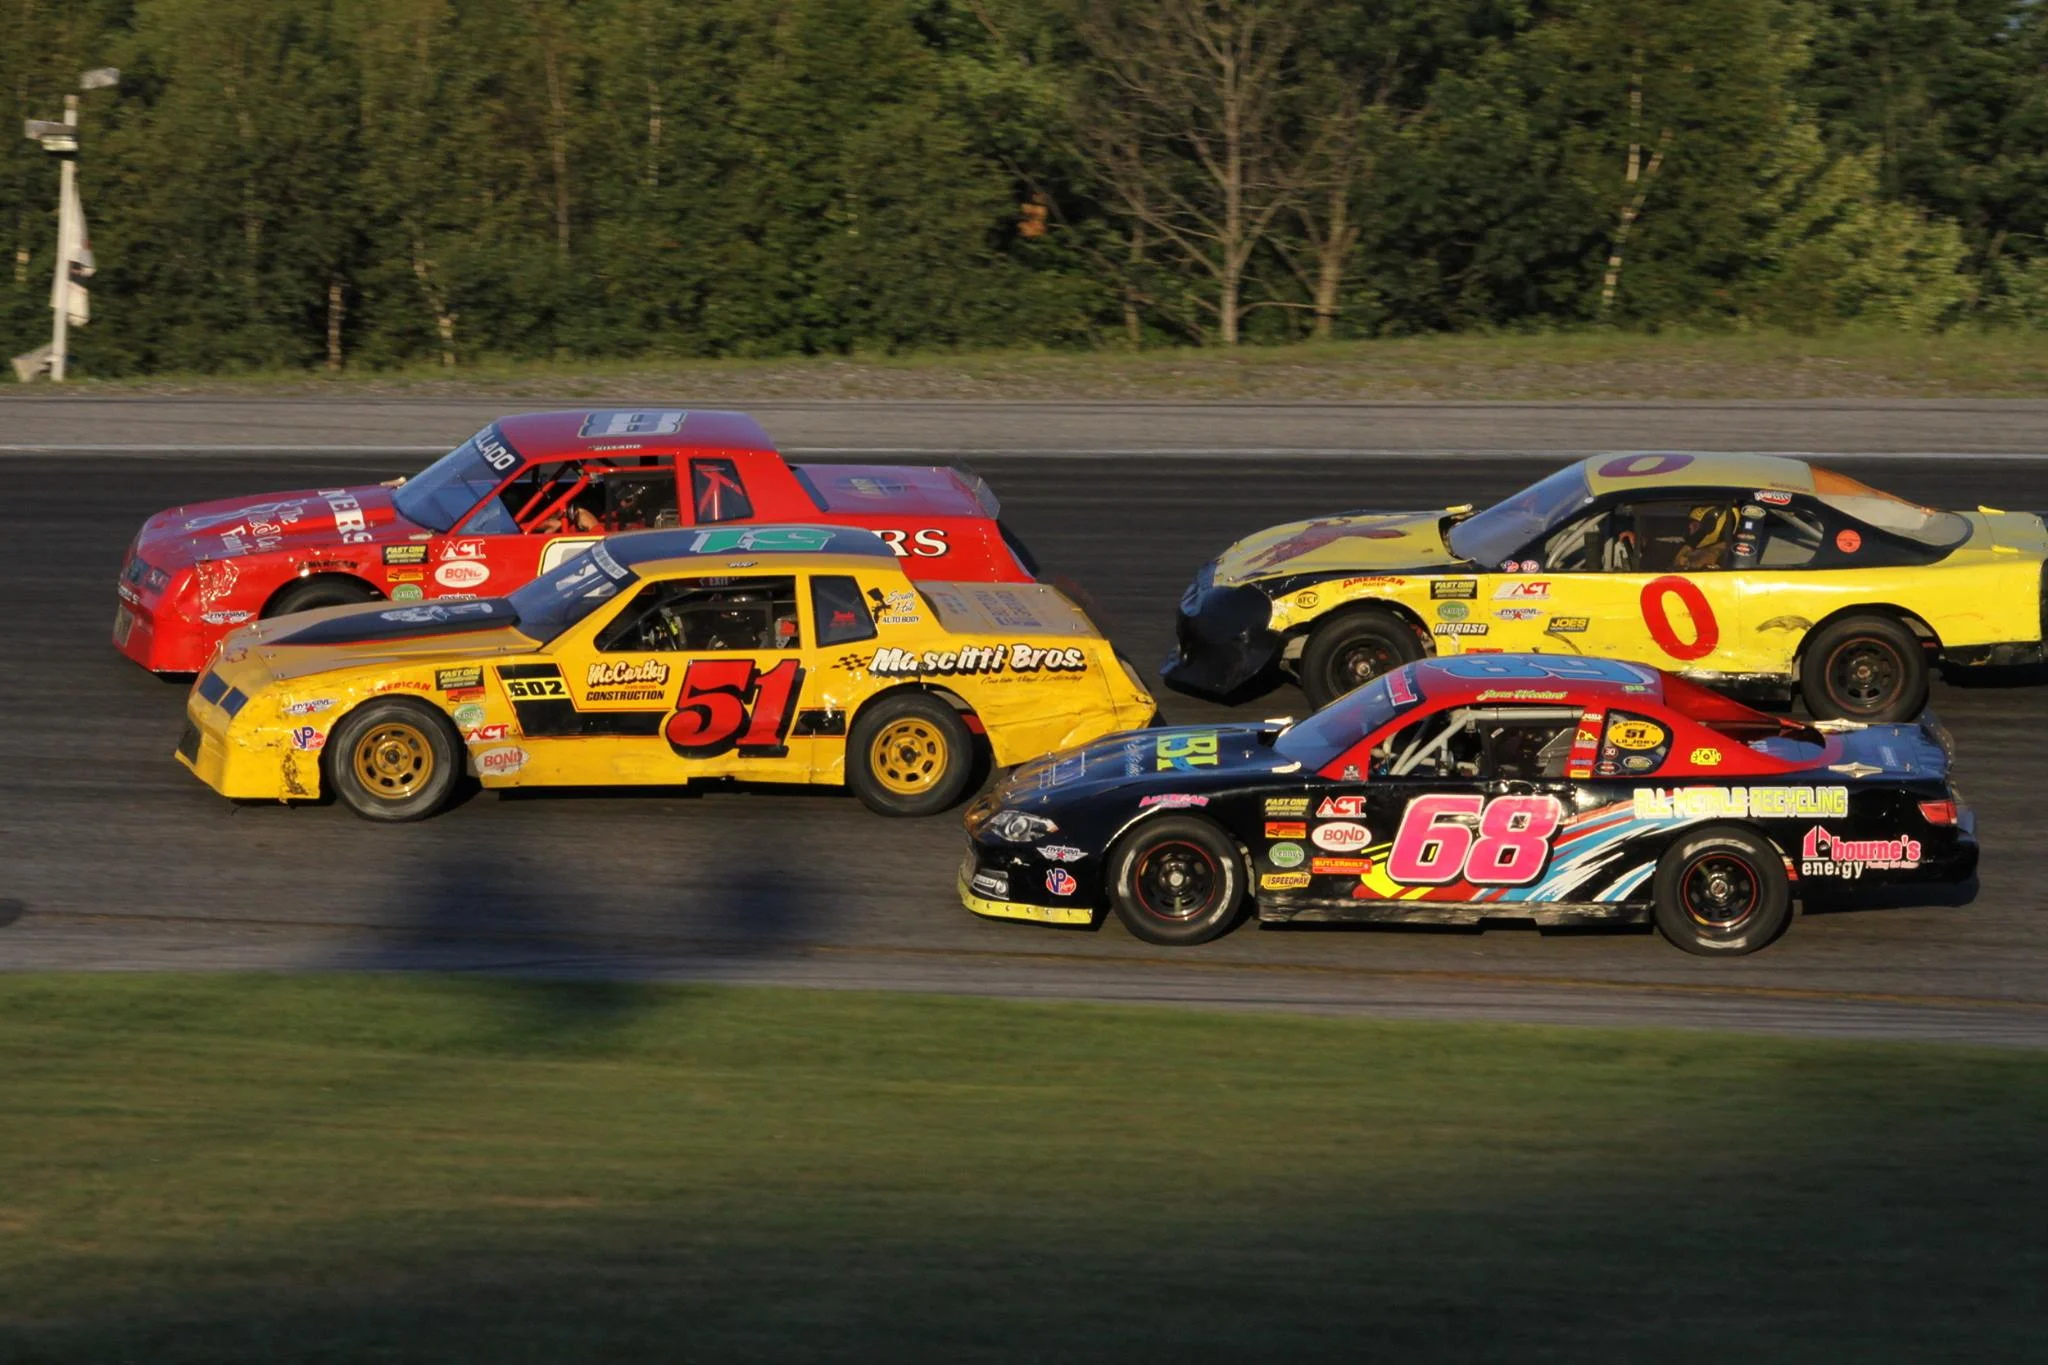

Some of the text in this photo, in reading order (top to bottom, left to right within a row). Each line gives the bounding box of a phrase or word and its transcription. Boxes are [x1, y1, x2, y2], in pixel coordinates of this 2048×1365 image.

[440, 538, 487, 560] ACT
[1342, 575, 1406, 588] AMERICAN
[1512, 582, 1551, 595] ACT
[1501, 608, 1518, 616] FIVE
[1640, 575, 1720, 661] 0
[1551, 618, 1586, 627] JOES
[1010, 643, 1088, 673] Bros.
[588, 660, 669, 687] McCarthy
[507, 680, 567, 697] 602
[586, 690, 665, 701] CONSTRUCTION
[664, 658, 806, 759] 51
[293, 726, 315, 749] VP
[465, 724, 510, 740] ACT
[1625, 729, 1647, 739] 51
[483, 750, 523, 768] BOND
[1315, 795, 1367, 818] ACT
[1749, 787, 1849, 819] RECYCLING
[1323, 827, 1365, 845] BOND
[1386, 793, 1564, 886] 68
[1831, 834, 1921, 861] bourne's
[1801, 861, 1864, 880] energy
[1046, 868, 1068, 894] VP
[1271, 876, 1308, 885] SPEEDWAY
